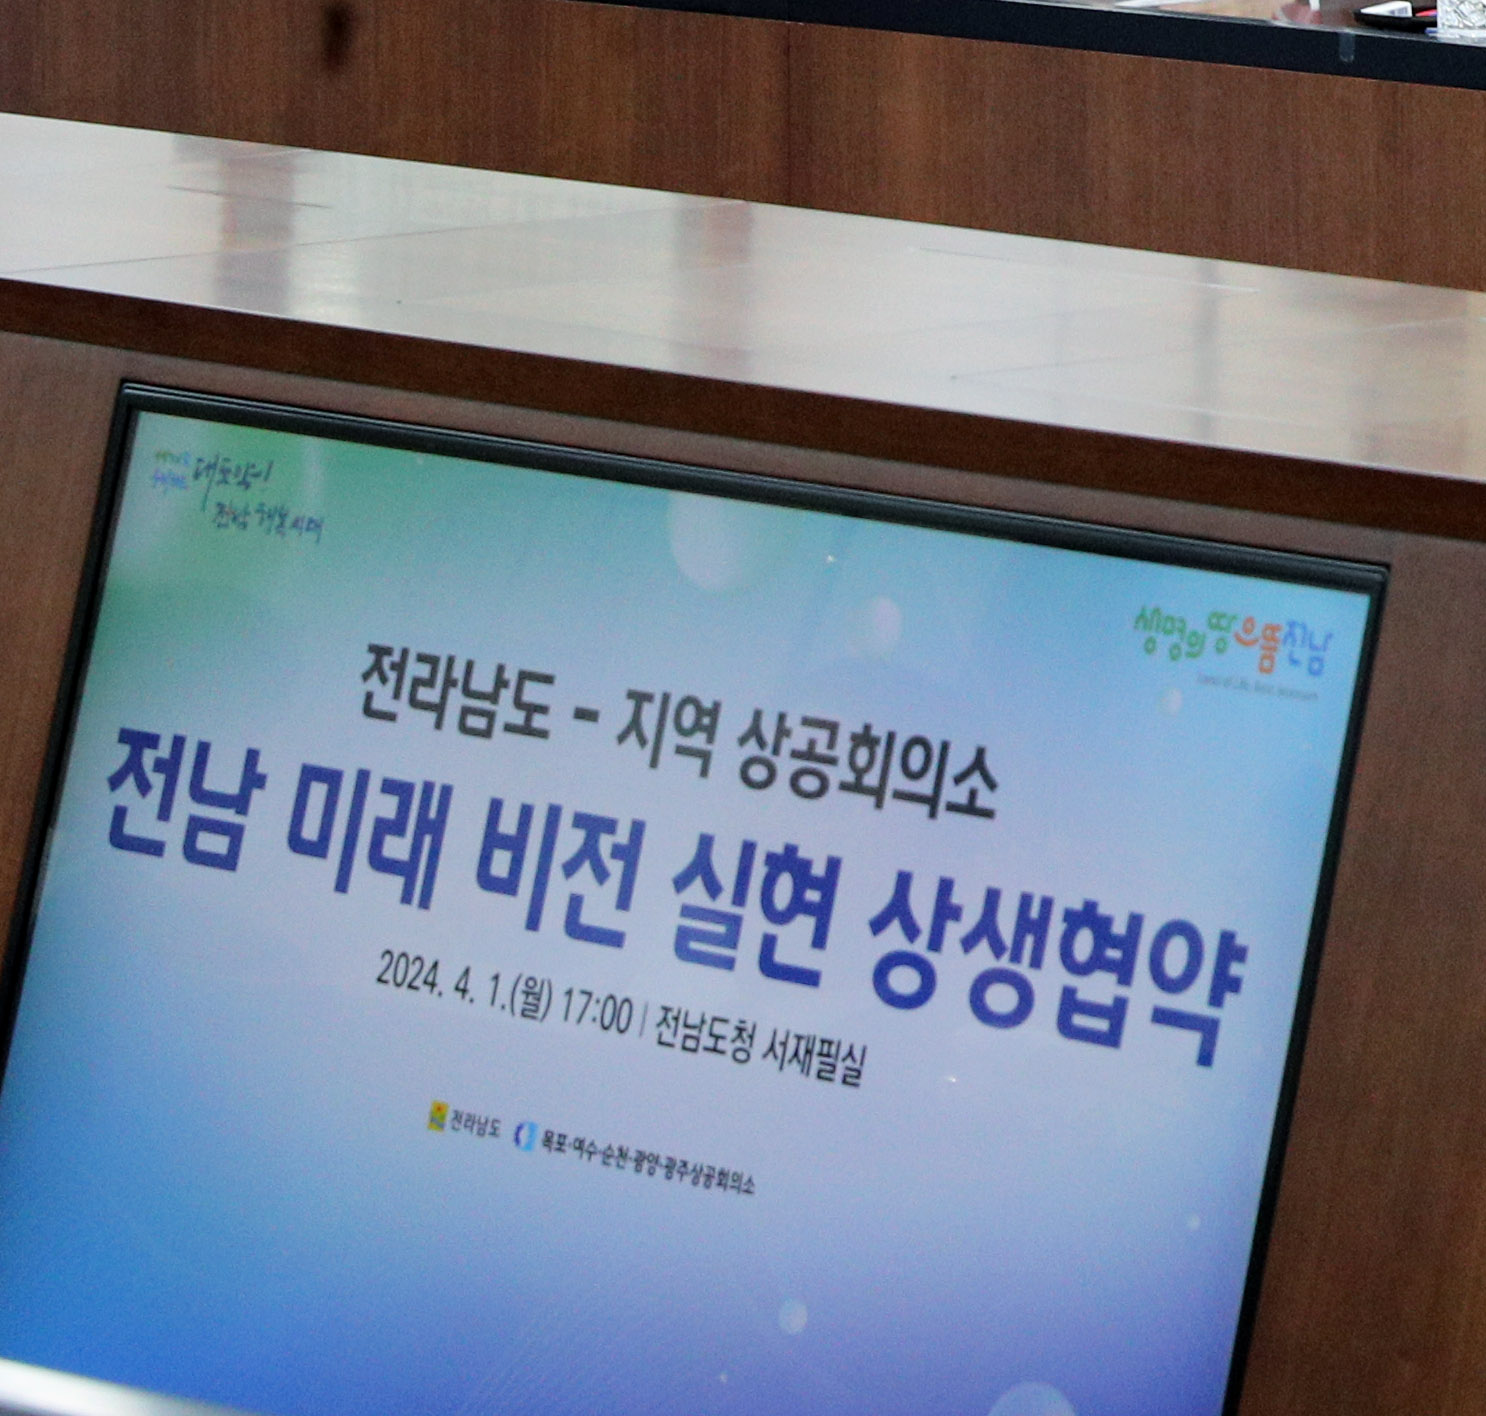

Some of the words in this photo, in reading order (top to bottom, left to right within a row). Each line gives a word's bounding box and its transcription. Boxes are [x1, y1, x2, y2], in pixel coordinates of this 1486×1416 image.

[361, 643, 556, 741] 전라남도
[616, 688, 722, 779] 지역
[737, 708, 998, 821] 상공회의소
[106, 726, 267, 873] 전남
[287, 762, 454, 911] 미래
[476, 797, 646, 949] 비전
[672, 833, 842, 988] 실현
[868, 869, 1249, 1068] 상생협약
[376, 948, 443, 998] 2024.
[453, 965, 475, 1004] 4.
[490, 972, 553, 1023] 1.(월)
[563, 987, 634, 1035] 17:00
[655, 1005, 757, 1065] 전남도청
[761, 1028, 868, 1088] 서재필실
[451, 1109, 502, 1138] 전라남도
